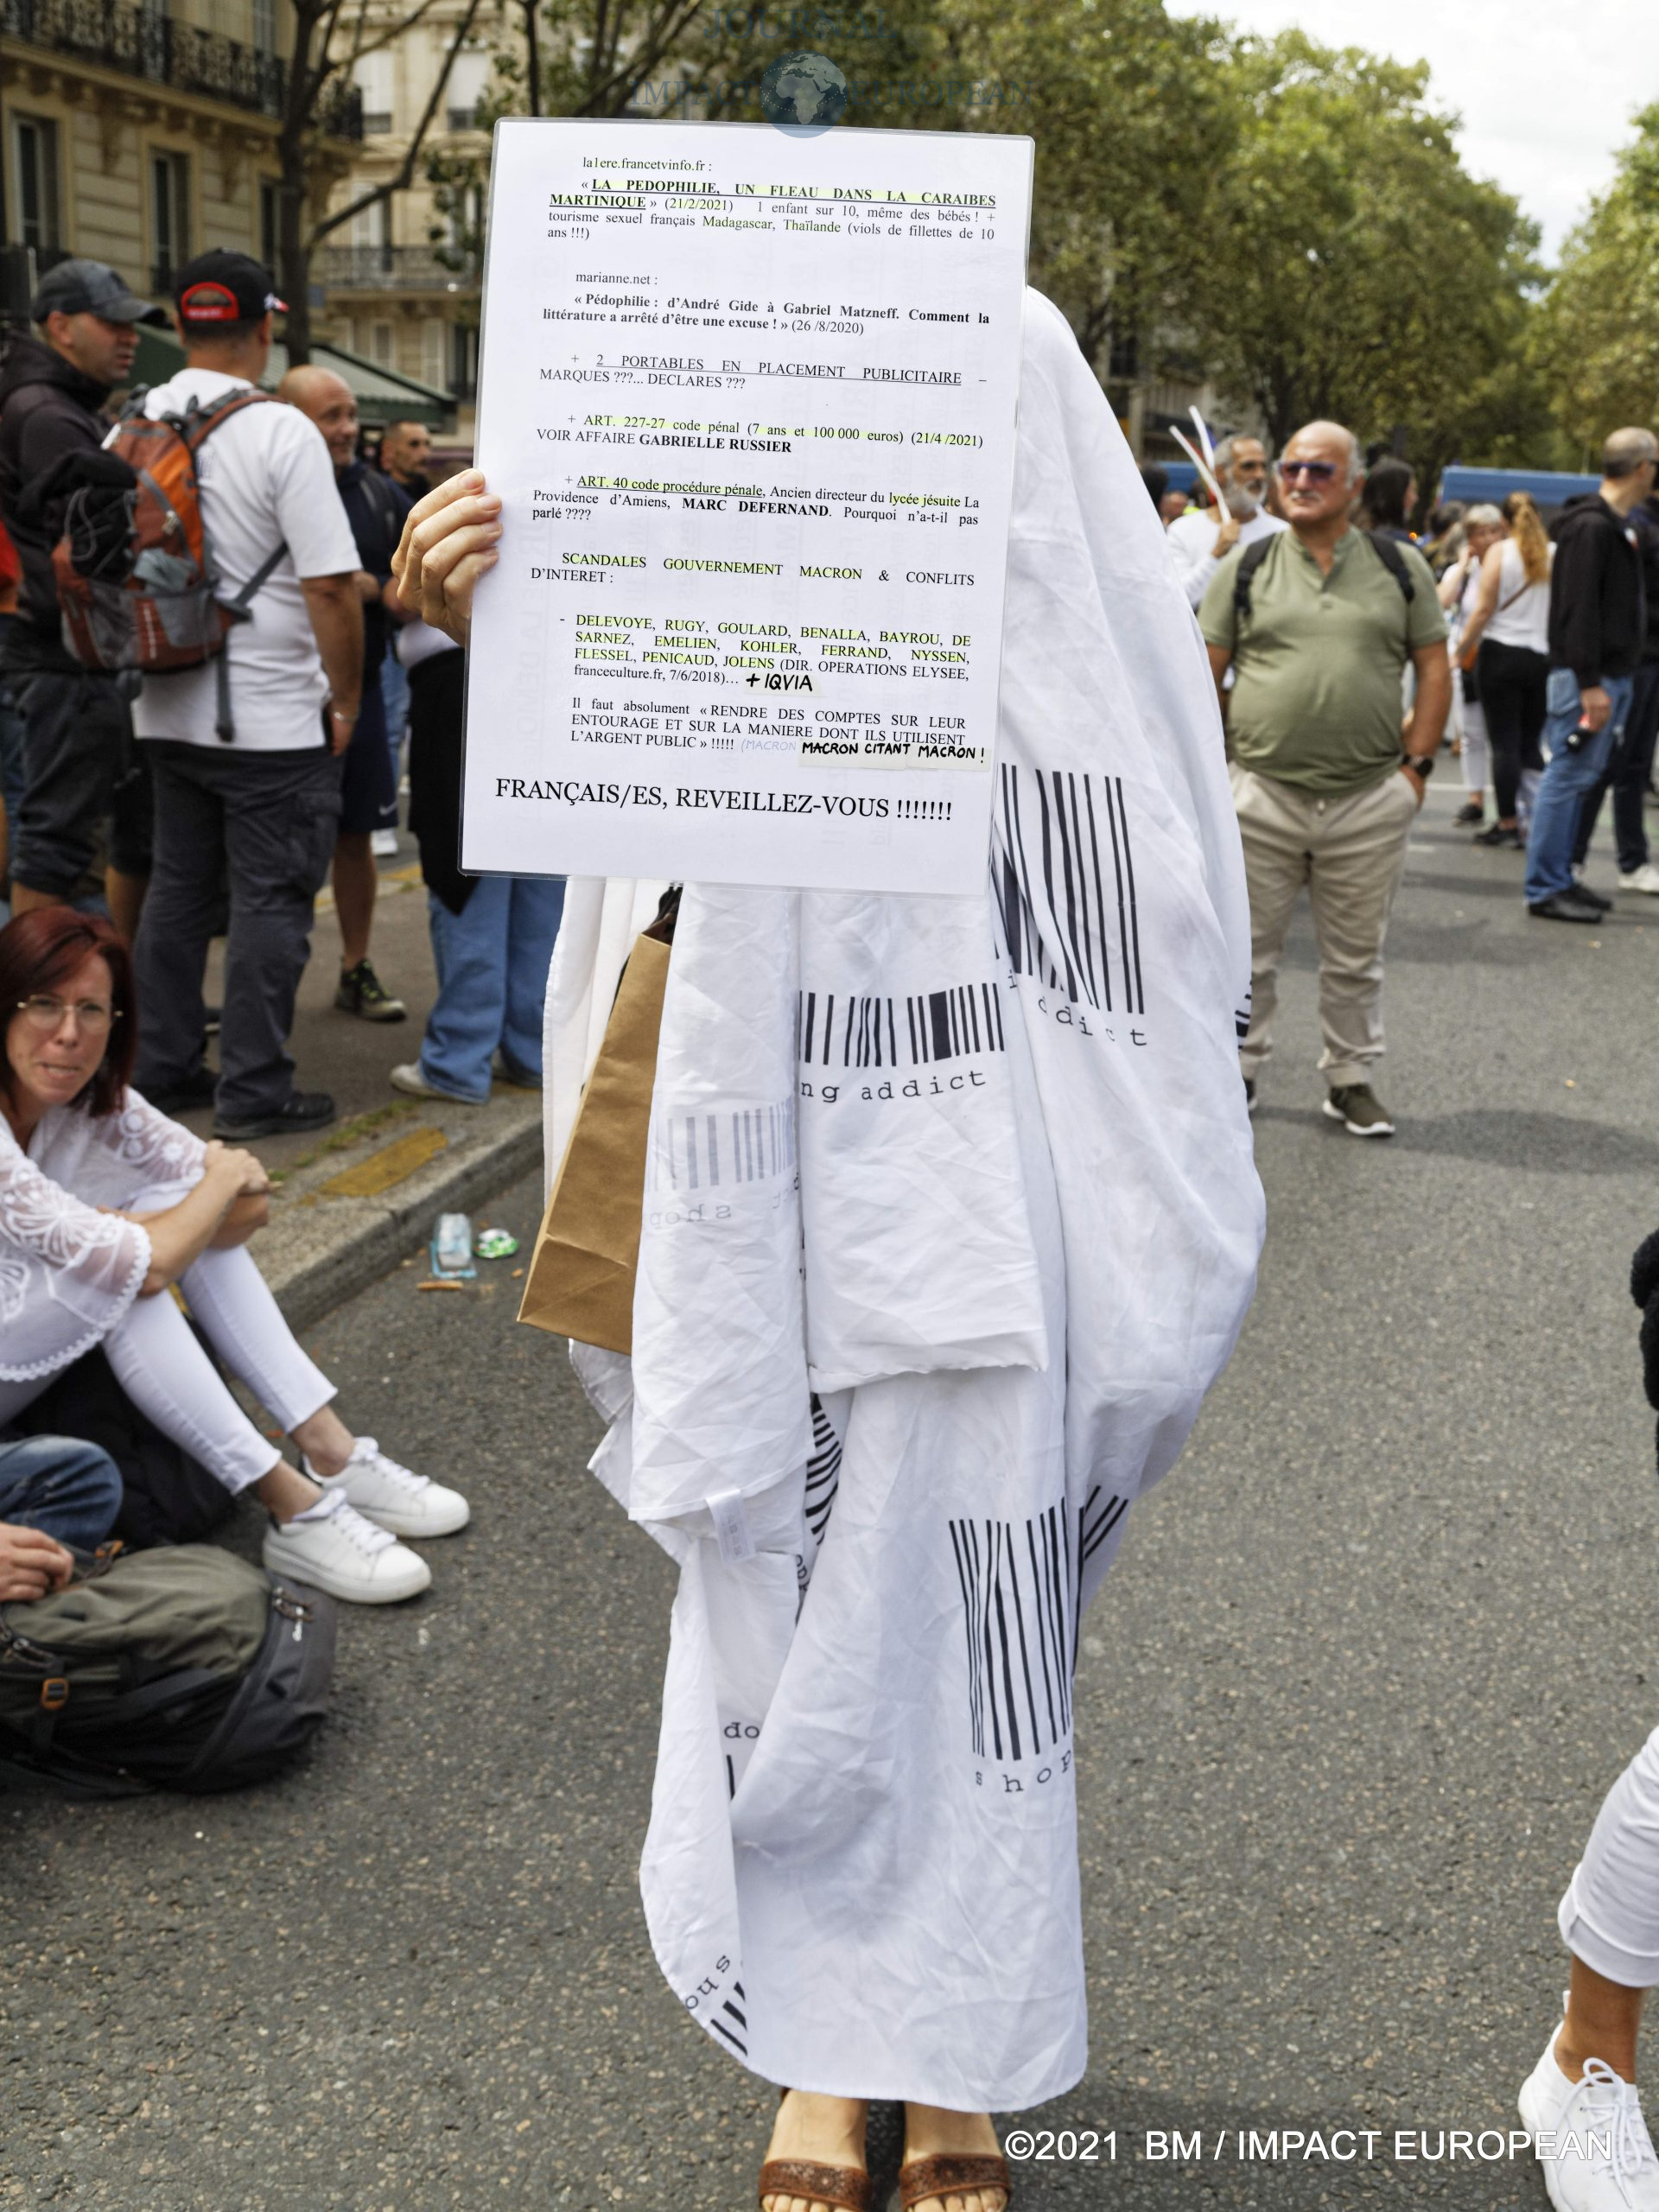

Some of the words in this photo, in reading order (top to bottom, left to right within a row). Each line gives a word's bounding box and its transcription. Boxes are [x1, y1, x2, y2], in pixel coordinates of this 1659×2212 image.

[592, 178, 612, 190] LA
[626, 179, 721, 194] PEDOPHILIE,
[735, 183, 756, 195] UN
[770, 185, 818, 199] FLEAU
[833, 188, 873, 201] DANS
[887, 190, 906, 202] LA
[921, 192, 996, 207] CARAIBES
[550, 194, 646, 207] MARTINIQUE
[664, 197, 734, 214] (21/2/2021)
[758, 200, 762, 213] 1
[772, 202, 809, 214] enfant
[815, 207, 835, 216] sur
[842, 205, 860, 219] 10,
[867, 207, 903, 219] même
[910, 208, 930, 220] des
[938, 209, 971, 222] bébés
[547, 229, 567, 238] ans
[549, 210, 600, 223] tourisme
[606, 213, 643, 224] sexuel
[650, 213, 696, 228] français
[702, 215, 776, 232] Madagascar,
[783, 219, 842, 232] Thaïlande
[848, 221, 881, 236] (viols
[887, 224, 902, 236] de
[909, 225, 952, 238] fillettes
[958, 227, 974, 239] de
[982, 228, 995, 240] 10
[575, 271, 651, 285] marianne.net
[543, 308, 607, 321] littérature
[609, 314, 617, 322] a
[620, 312, 659, 324] arrêté
[702, 318, 725, 327] une
[728, 319, 769, 329] excuse
[586, 293, 651, 308] Pédophilie
[728, 299, 759, 312] Gide
[766, 301, 774, 313] à
[783, 302, 831, 315] Gabriel
[840, 305, 899, 320] Matzneff.
[908, 308, 970, 323] Comment
[978, 312, 989, 324] la
[540, 368, 610, 384] MARQUES
[647, 372, 722, 388] DECLARES
[596, 353, 603, 365] 2
[621, 355, 704, 371] PORTABLES
[721, 359, 741, 372] EN
[758, 361, 846, 378] PLACEMENT
[862, 367, 962, 385] PUBLICITAIRE
[537, 429, 571, 442] VOIR
[575, 430, 635, 445] AFFAIRE
[639, 433, 726, 449] GABRIELLE
[728, 438, 792, 453] RUSSIER
[583, 414, 616, 427] ART.
[624, 416, 666, 429] 227-27
[672, 419, 701, 431] code
[708, 421, 740, 435] pénal
[747, 423, 760, 437] (7
[766, 426, 786, 436] ans
[794, 427, 805, 437] et
[867, 430, 904, 445] euros)
[576, 474, 609, 488] ART.
[613, 477, 628, 489] 40
[631, 479, 659, 491] code
[663, 480, 721, 494] procédure
[723, 483, 766, 499] pénale,
[769, 486, 811, 499] Ancien
[815, 487, 868, 502] directeur
[870, 491, 885, 503] du
[888, 492, 919, 506] lycée
[920, 493, 961, 508] jésuite
[963, 496, 980, 509] La
[532, 506, 562, 521] parlé
[533, 489, 599, 505] Providence
[682, 497, 728, 512] MARC
[738, 500, 832, 518] DEFERNAND.
[843, 506, 897, 523] Pourquoi
[958, 516, 979, 527] pas
[562, 552, 647, 569] SCANDALES
[663, 557, 784, 575] GOUVERNEMENT
[799, 565, 862, 580] MACRON
[878, 569, 890, 582] &
[906, 571, 975, 587] CONFLITS
[575, 614, 656, 632] DELEVOYE,
[664, 619, 709, 635] RUGY,
[717, 621, 791, 639] GOULARD,
[799, 626, 870, 644] BENALLA,
[879, 630, 944, 647] BAYROU,
[952, 634, 971, 647] DE
[575, 630, 634, 647] SARNEZ,
[654, 635, 721, 652] EMELIEN,
[740, 639, 802, 657] KOHLER,
[821, 644, 892, 661] FERRAND,
[911, 649, 969, 665] NYSSEN,
[574, 647, 637, 664] FLESSEL,
[642, 651, 718, 669] PENICAUD,
[722, 655, 775, 670] JOLENS
[779, 658, 813, 672] (DIR.
[817, 660, 907, 677] OPERATIONS
[912, 665, 969, 682] ELYSEE,
[574, 664, 666, 683] franceculture.fr,
[764, 672, 813, 692] IQVIA
[572, 696, 581, 709] Il
[591, 697, 614, 711] faut
[623, 700, 690, 715] absolument
[710, 704, 768, 719] RENDRE
[778, 708, 804, 721] DES
[815, 710, 881, 725] COMPTES
[891, 714, 919, 727] SUR
[929, 716, 966, 729] LEUR
[571, 714, 659, 729] ENTOURAGE
[665, 718, 683, 731] ET
[689, 720, 716, 733] SUR
[722, 721, 741, 734] LA
[747, 723, 813, 738] MANIERE
[818, 727, 860, 741] DONT
[864, 729, 887, 742] ILS
[893, 731, 966, 746] UTILISENT
[645, 734, 696, 748] PUBLIC
[802, 741, 859, 755] MACRON
[864, 742, 912, 755] CITANT
[918, 744, 976, 760] MACRON
[495, 778, 668, 810] FRANÇAIS/ES,
[675, 787, 889, 818] REVEILLEZ-VOUS
[861, 1070, 986, 1100] addict
